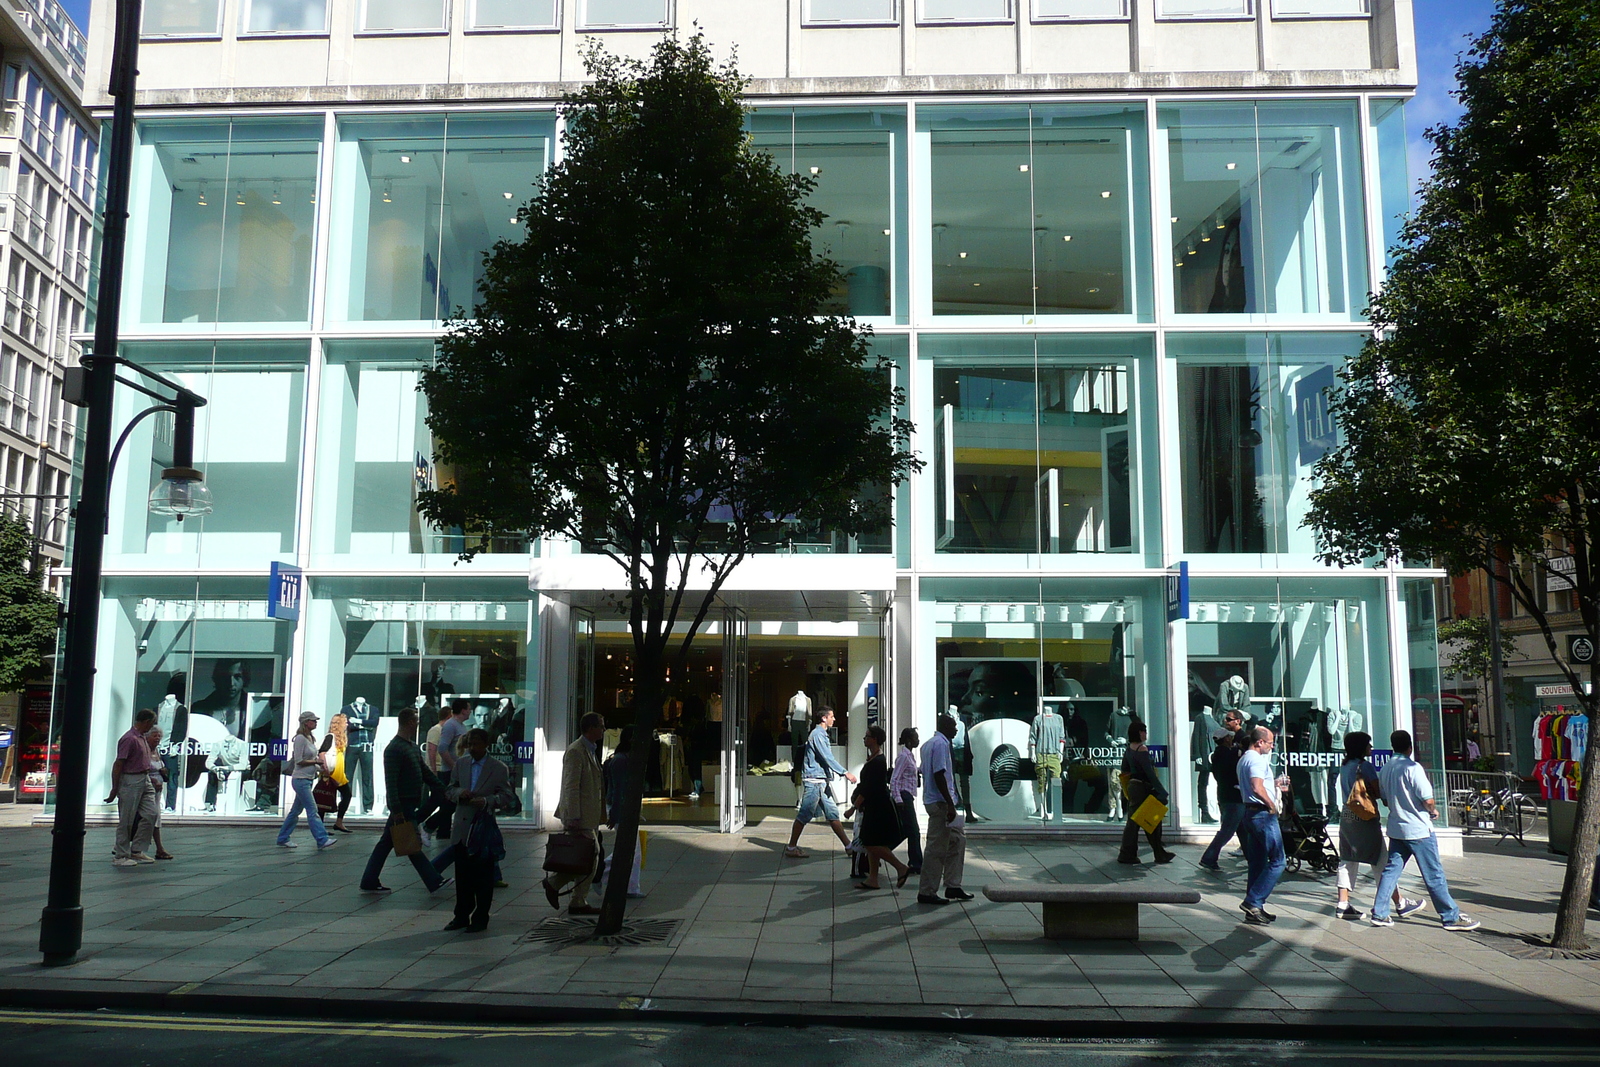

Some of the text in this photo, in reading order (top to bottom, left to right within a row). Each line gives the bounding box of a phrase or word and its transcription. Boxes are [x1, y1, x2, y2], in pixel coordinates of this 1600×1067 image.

[280, 581, 297, 609] GAP
[1541, 685, 1574, 695] SOUVENIR
[272, 743, 288, 757] GAP
[517, 745, 533, 759] GAP
